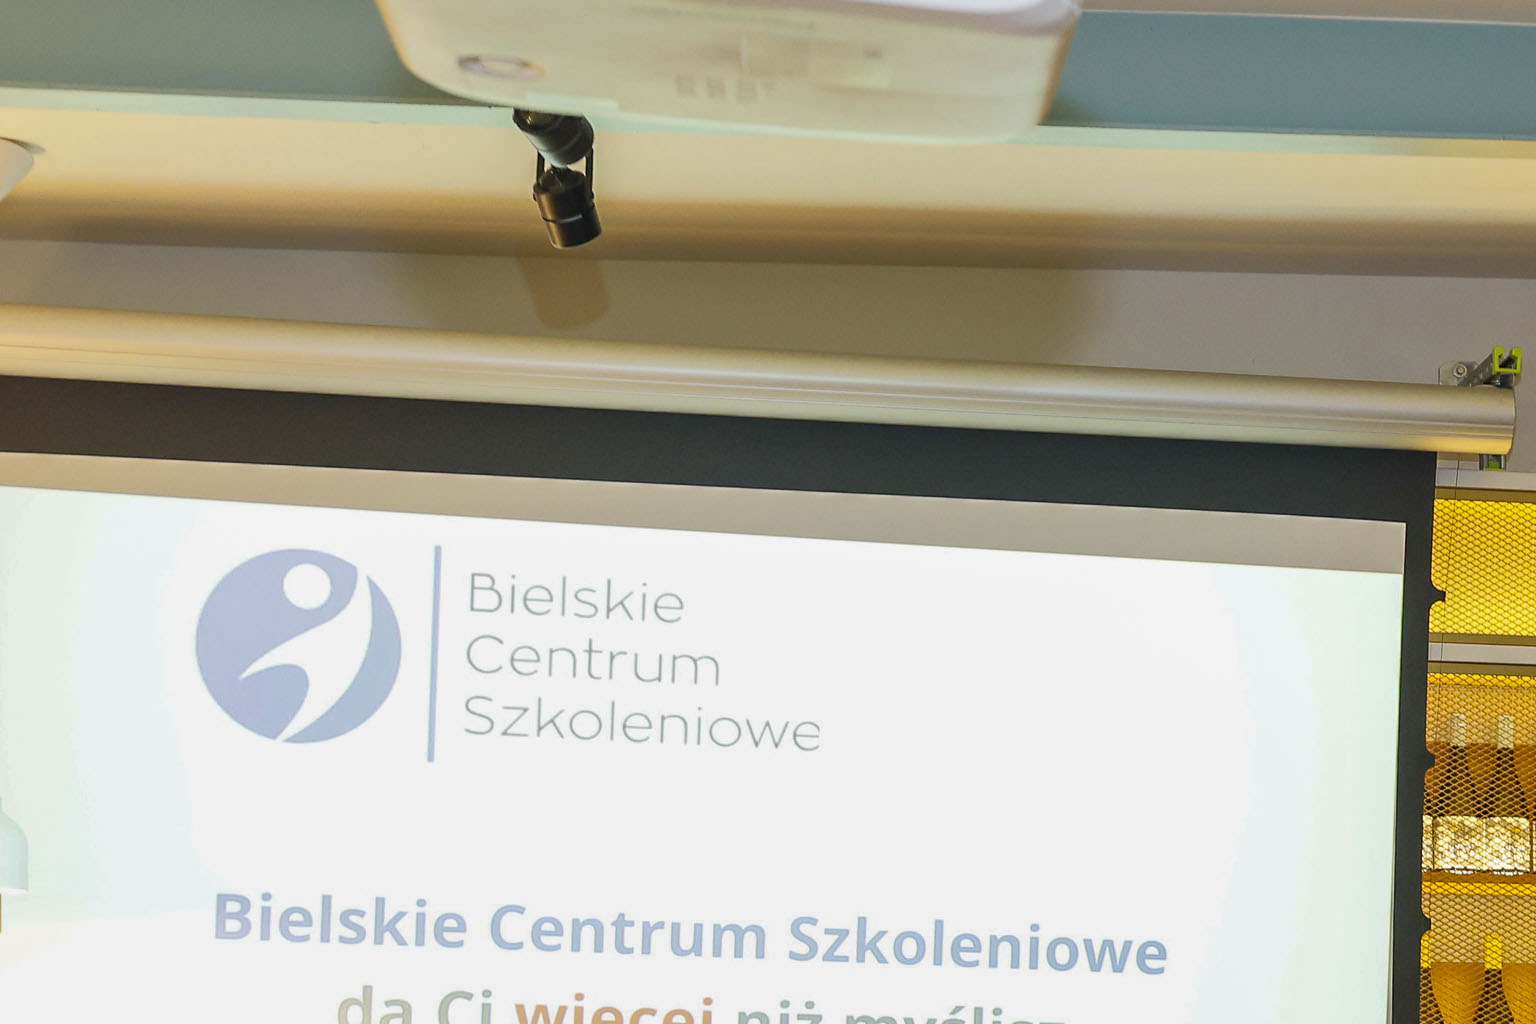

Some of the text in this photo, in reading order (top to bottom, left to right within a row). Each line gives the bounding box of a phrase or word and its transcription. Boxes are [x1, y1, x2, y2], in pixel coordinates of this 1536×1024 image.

[469, 572, 685, 623] Bielskie
[466, 634, 720, 686] Centrum
[464, 695, 821, 751] Szkoleniowe
[213, 892, 1169, 975] Bielskie Centrum Szkoleniowe
